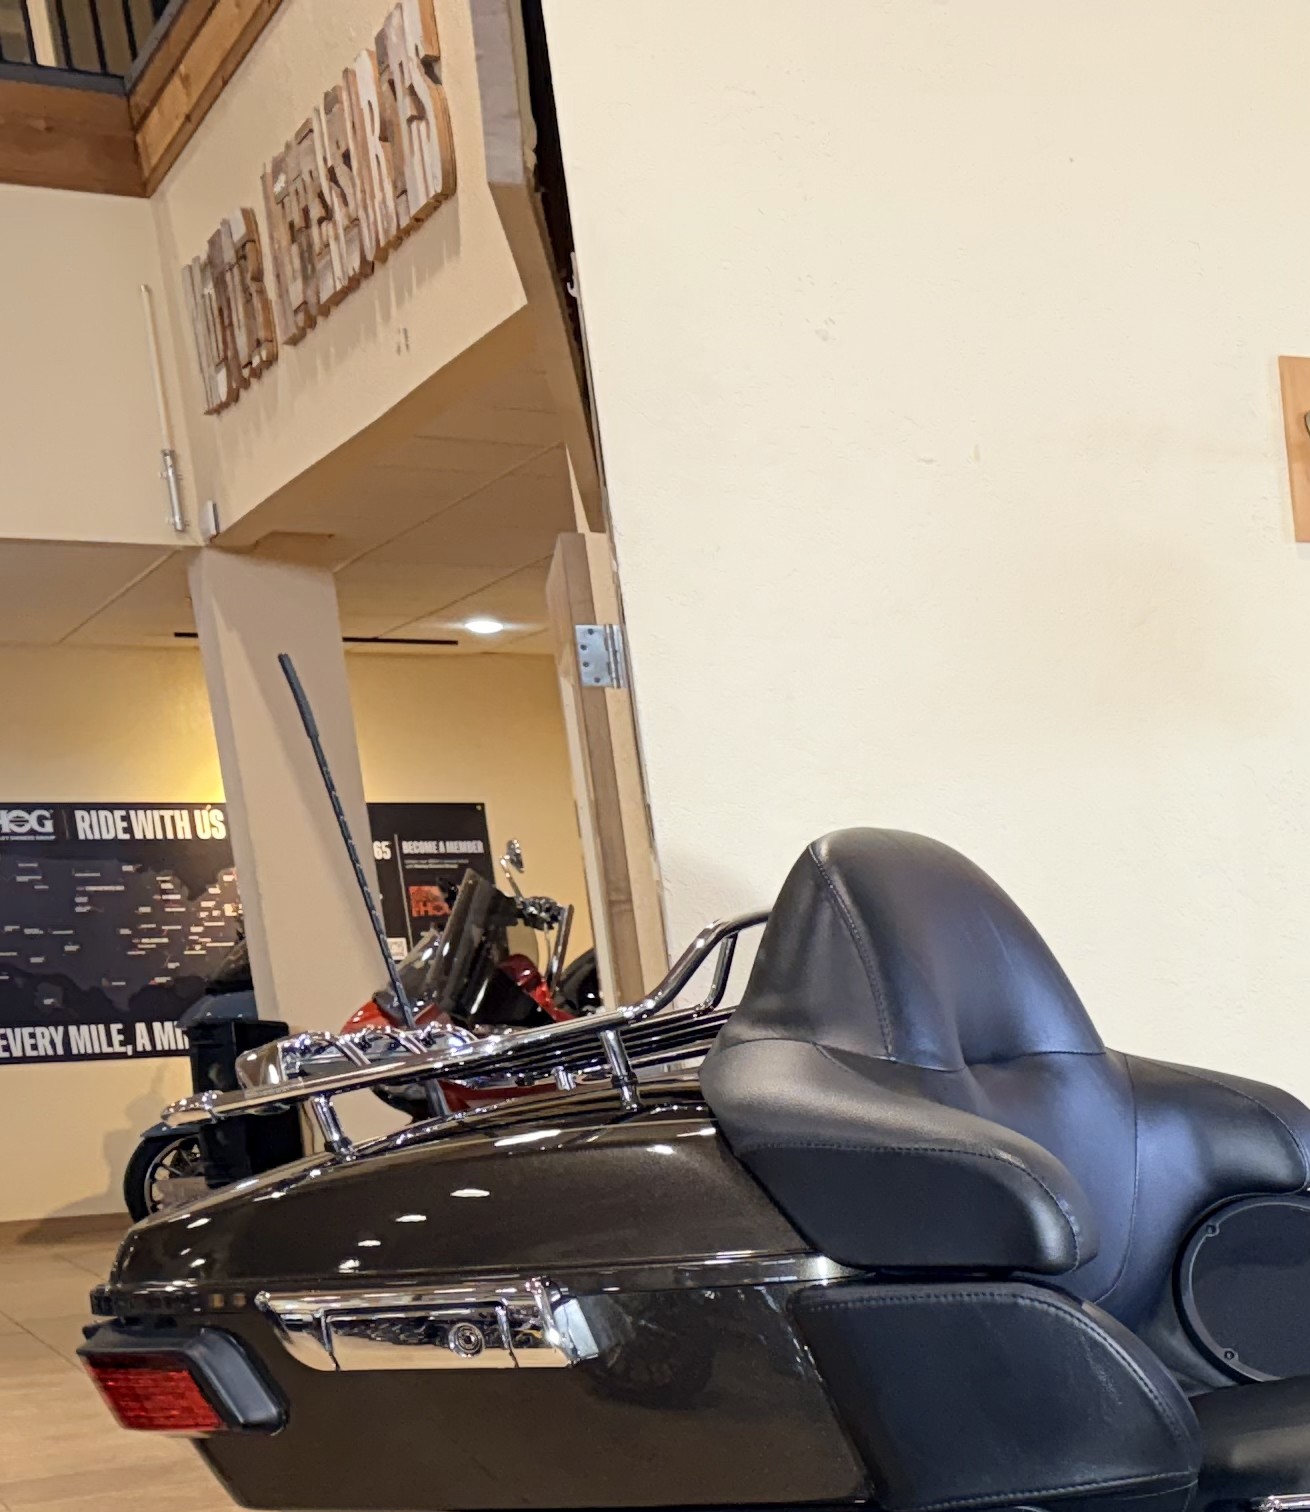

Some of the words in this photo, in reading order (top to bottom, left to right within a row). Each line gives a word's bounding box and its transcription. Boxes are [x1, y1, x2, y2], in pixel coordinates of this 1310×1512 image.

[74, 809, 130, 840] RIDE
[130, 809, 193, 840] WITH
[0, 1025, 64, 1057] EVERY
[68, 1022, 133, 1056] MILE,
[135, 1021, 152, 1051] A
